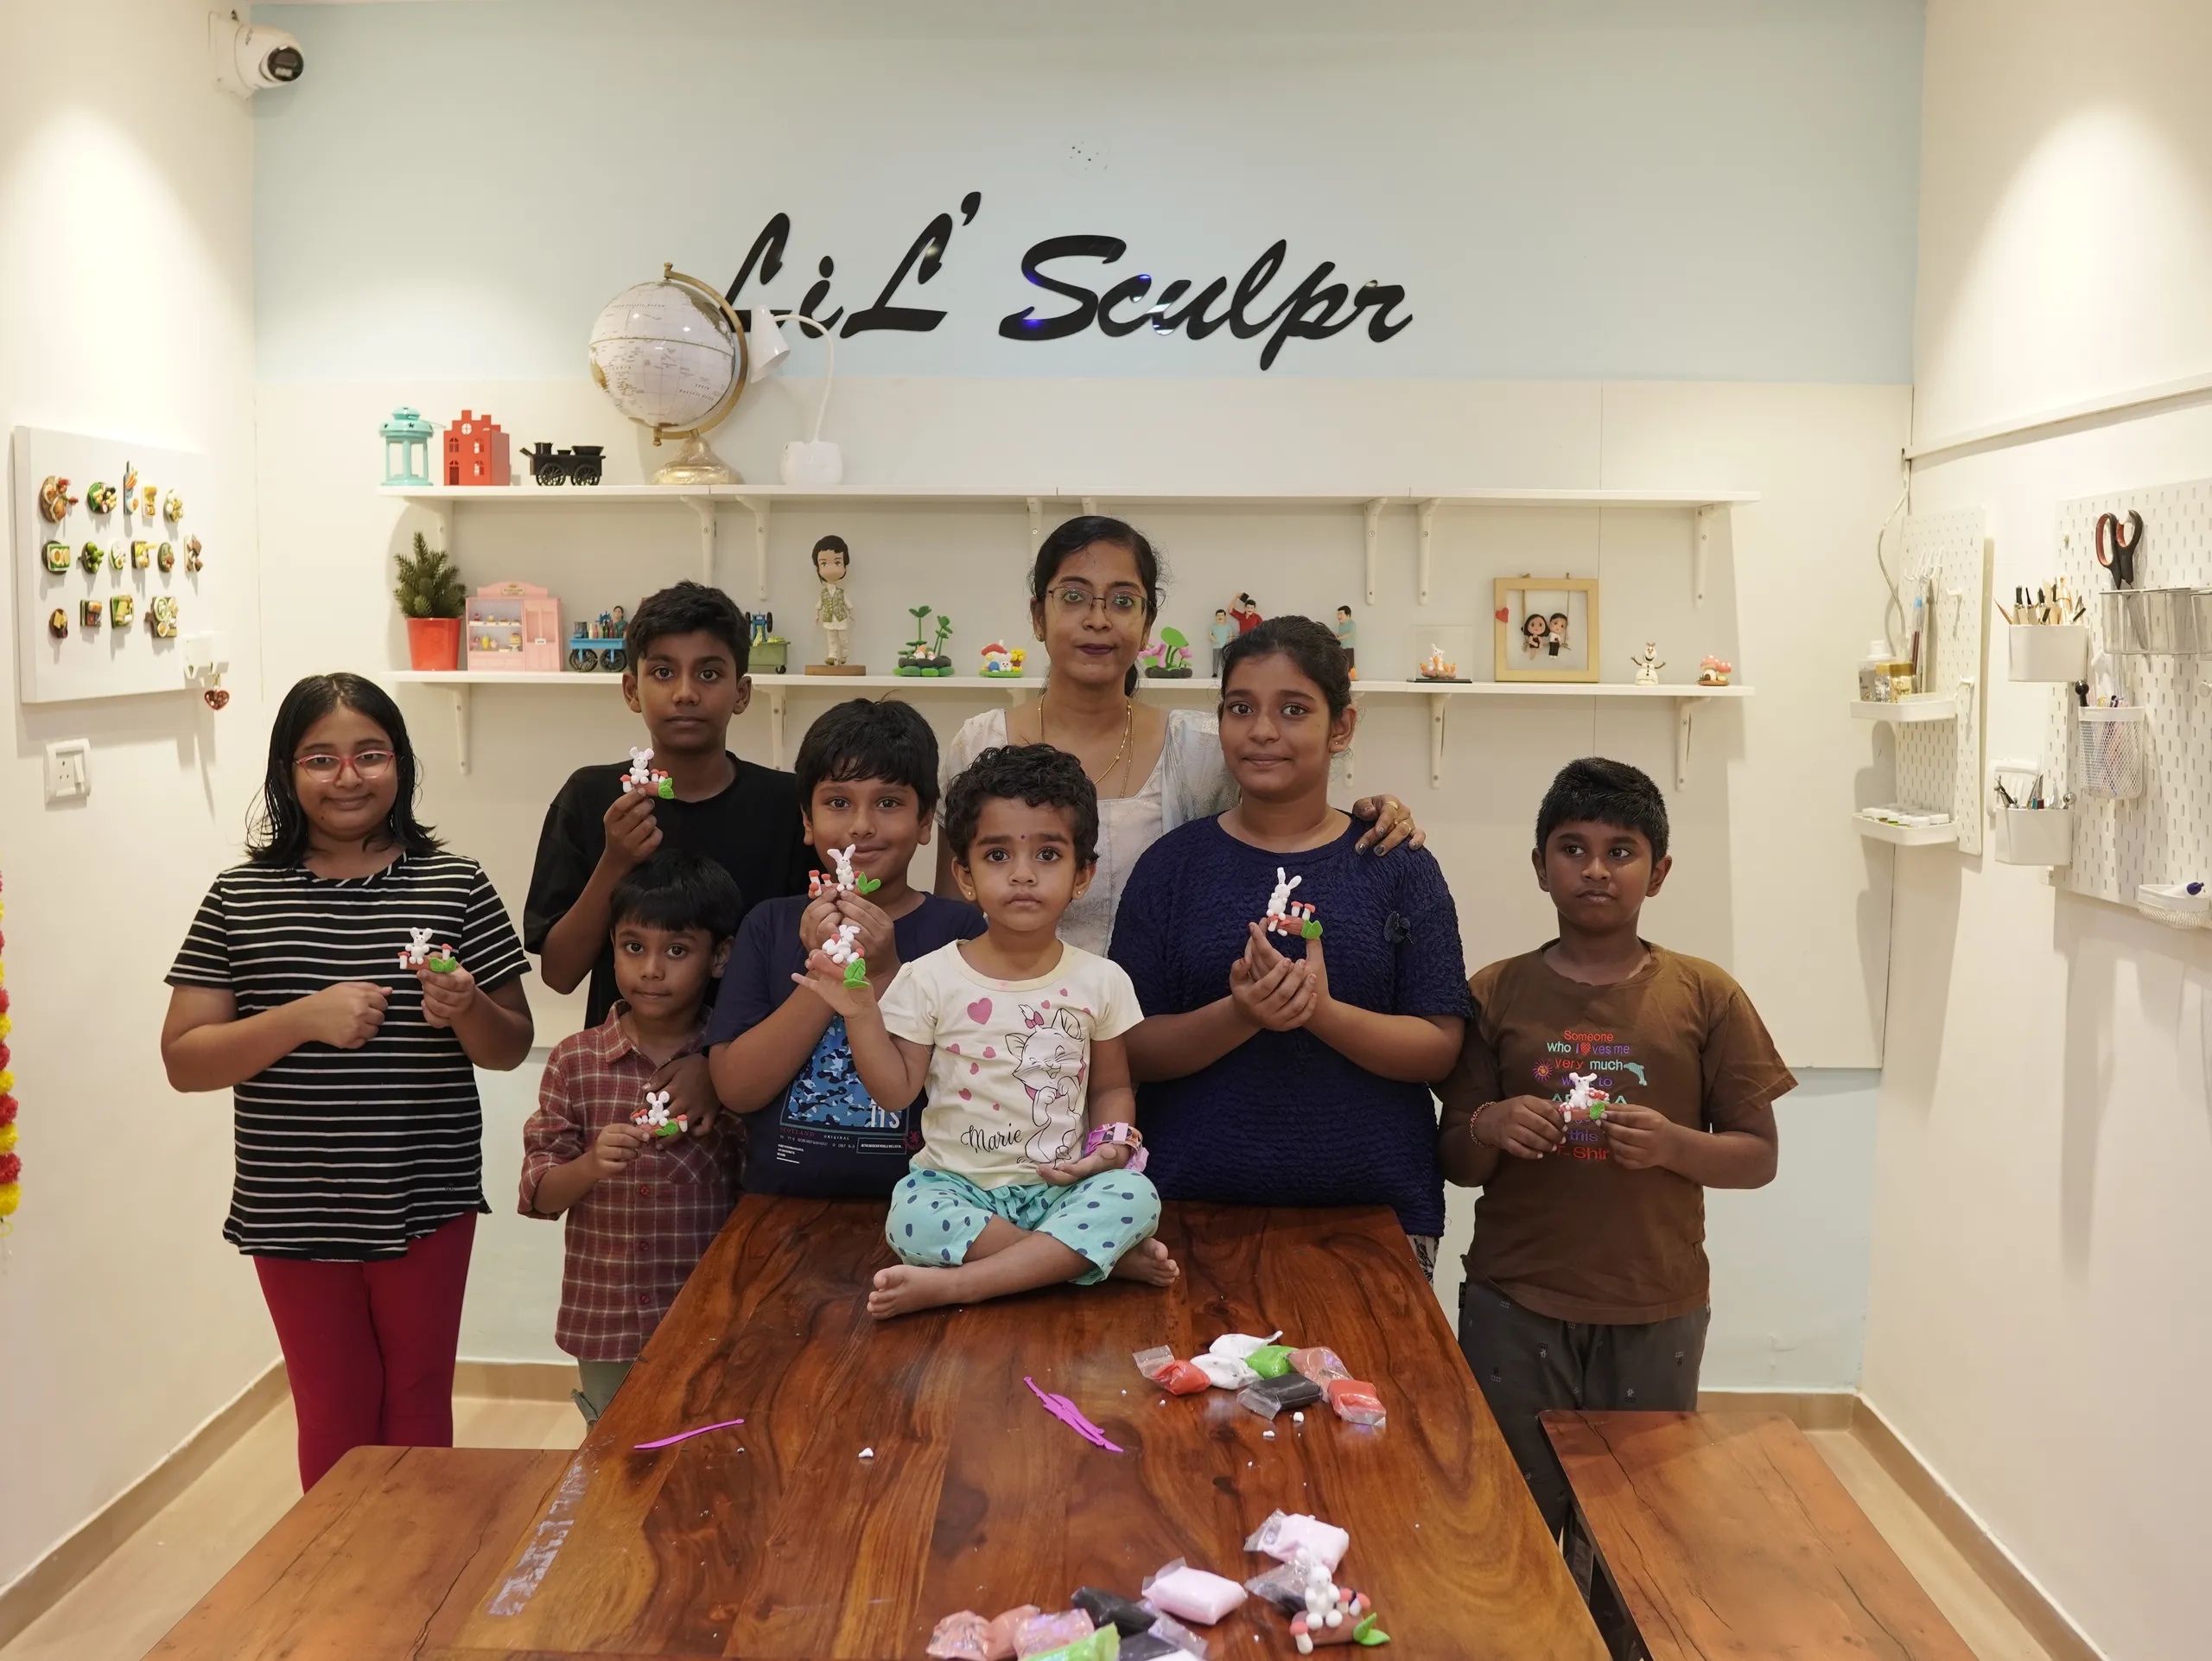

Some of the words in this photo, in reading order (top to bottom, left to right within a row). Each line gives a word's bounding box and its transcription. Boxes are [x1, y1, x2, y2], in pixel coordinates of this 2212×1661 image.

[719, 191, 982, 339] LiL'
[998, 234, 1414, 372] Sculpr
[1563, 1029, 1614, 1042] Someone
[1547, 1041, 1572, 1053] who
[1613, 1044, 1630, 1053] me
[1555, 1058, 1584, 1070] very
[1590, 1059, 1624, 1071] much
[1599, 1076, 1613, 1087] to
[780, 1126, 815, 1137] SCOTLAND
[1569, 1130, 1599, 1142] this
[960, 1123, 1023, 1154] Marie
